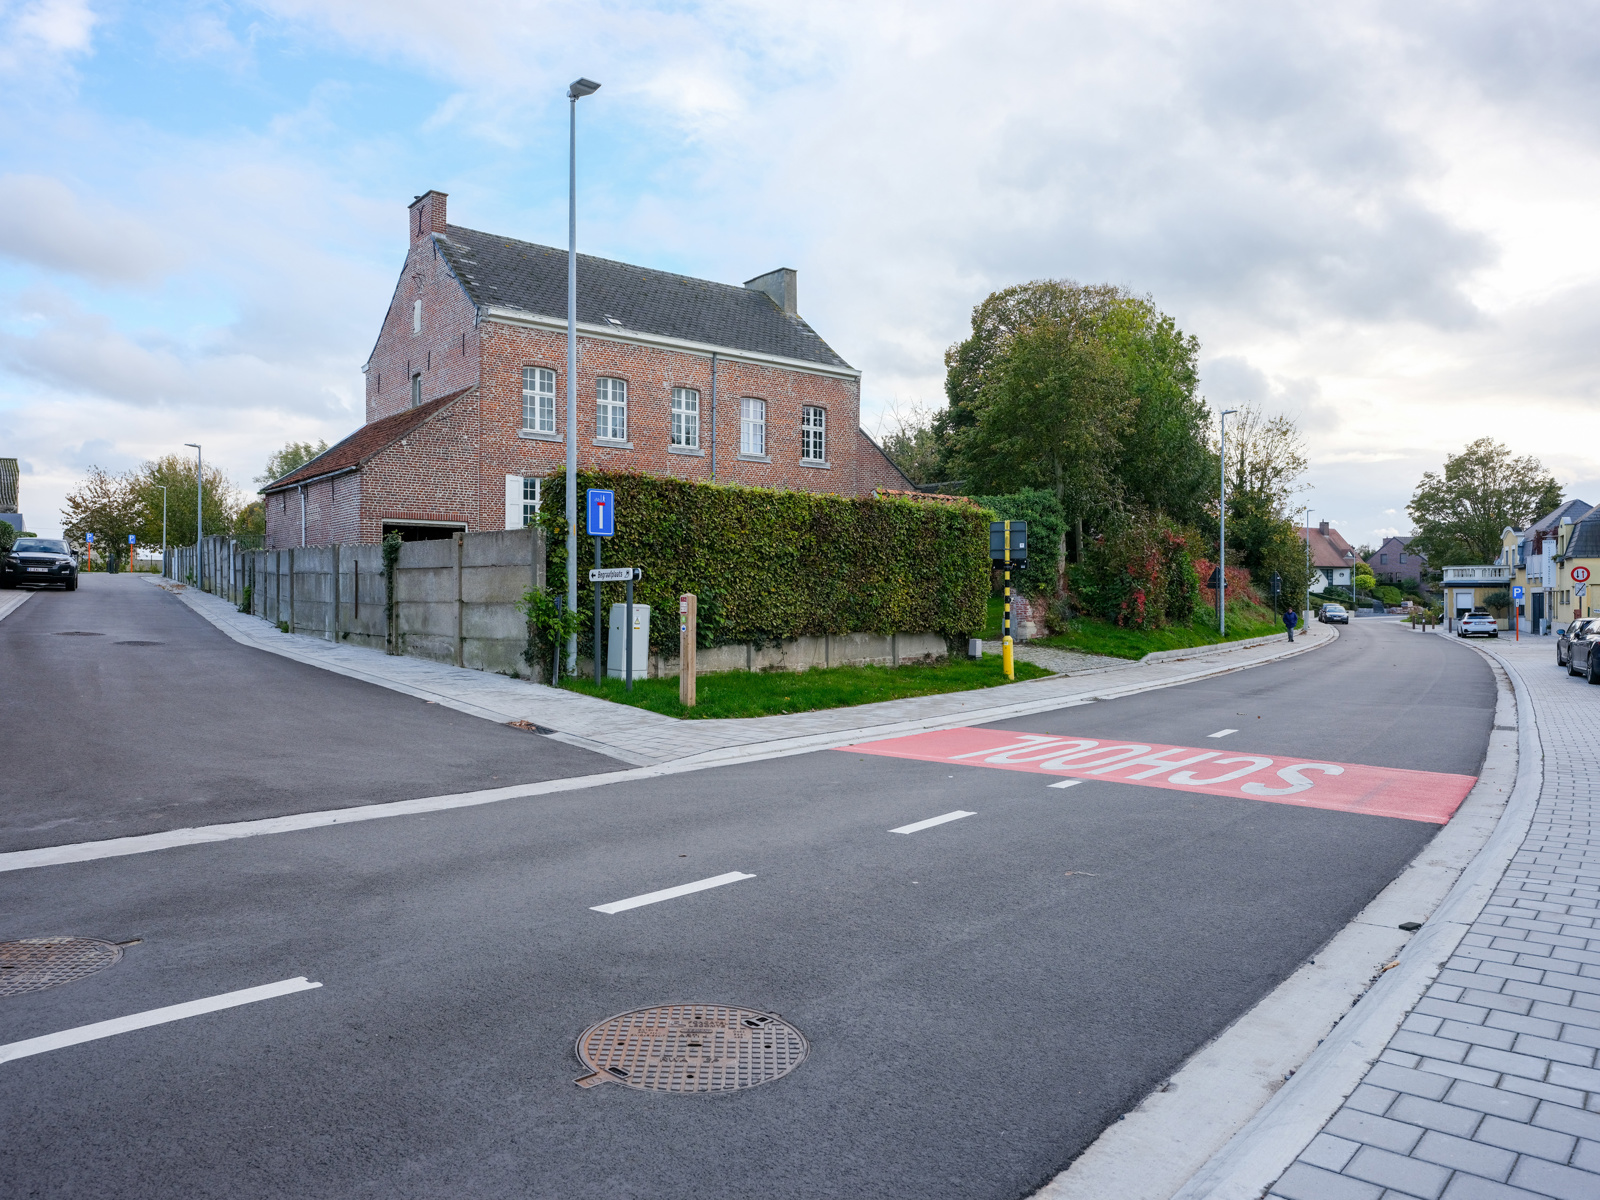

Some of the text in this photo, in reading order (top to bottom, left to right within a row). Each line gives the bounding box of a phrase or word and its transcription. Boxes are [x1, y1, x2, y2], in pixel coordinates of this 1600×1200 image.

[597, 570, 623, 580] Begraafplaats
[1514, 588, 1522, 597] P
[947, 735, 1345, 796] SCHOOL
